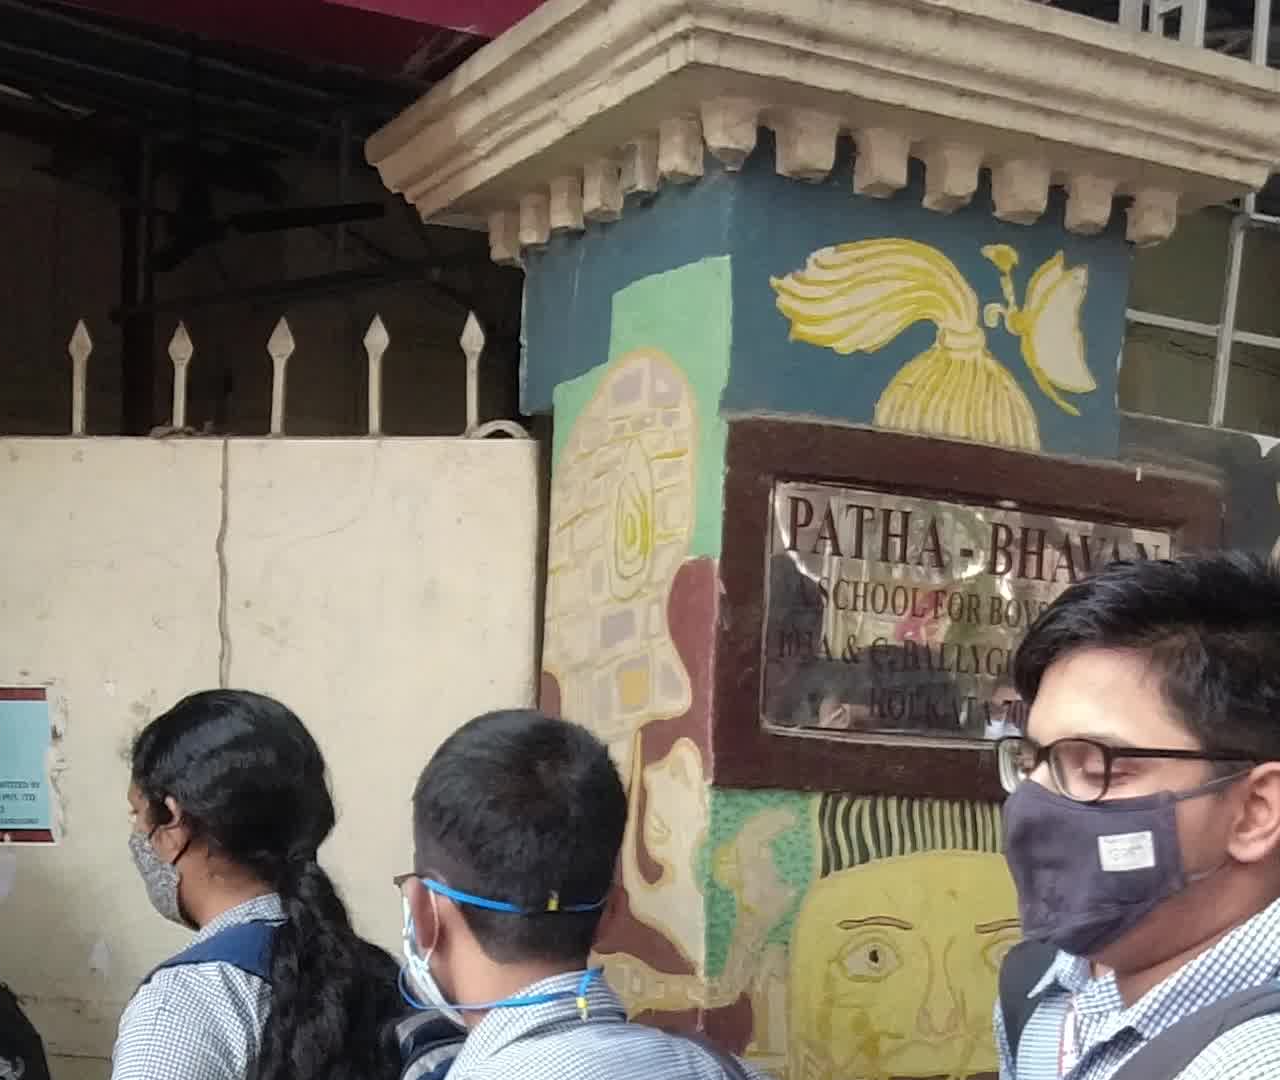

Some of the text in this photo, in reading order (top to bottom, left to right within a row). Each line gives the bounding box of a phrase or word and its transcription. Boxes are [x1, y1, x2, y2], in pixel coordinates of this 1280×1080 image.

[786, 496, 945, 570] PATHA
[819, 574, 926, 619] SCHOOL
[932, 588, 982, 624] FOR
[903, 640, 1012, 678] BALLYG
